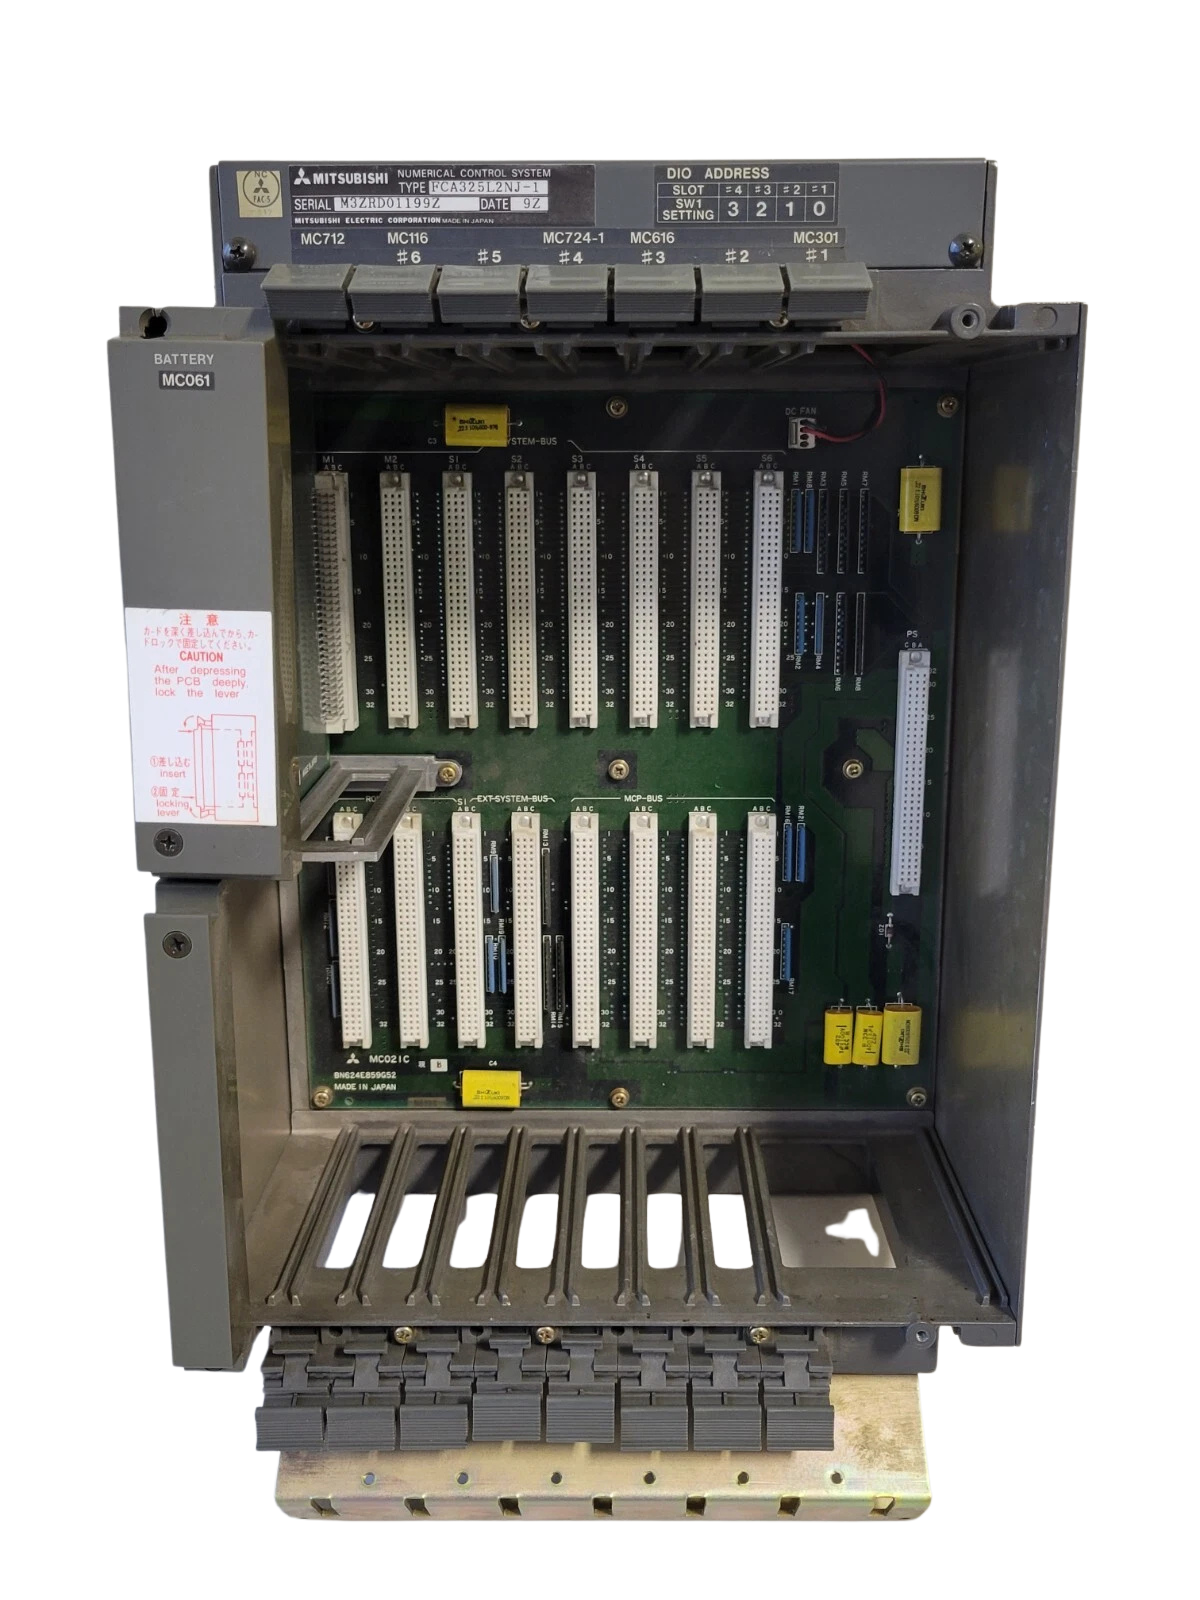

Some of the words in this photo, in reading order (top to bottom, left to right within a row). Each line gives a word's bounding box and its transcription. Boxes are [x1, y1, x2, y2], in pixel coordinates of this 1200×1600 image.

[313, 171, 389, 185] MITSUBISHI
[397, 168, 456, 178] NUMERICAL
[460, 168, 507, 178] CONTROL
[511, 168, 551, 178] SYSTEM
[666, 168, 692, 180] DIO
[704, 168, 770, 180] ADDRESS
[399, 182, 426, 194] TYPE
[431, 181, 540, 194] FCA325L2NJ-1
[672, 185, 704, 196] SLOT
[294, 199, 331, 211] SERIAL
[480, 198, 509, 211] DATE
[523, 198, 541, 210] 9Z
[675, 199, 702, 210] SW1
[727, 201, 739, 217] 3
[755, 201, 768, 217] 2
[785, 201, 795, 217] 1
[813, 201, 826, 217] 0
[294, 217, 341, 225] MITSUBISHI
[345, 217, 383, 225] ELECTRIC
[442, 217, 462, 225] MADE
[463, 217, 470, 225] IN
[470, 217, 495, 225] JAPAN
[662, 209, 715, 221] SETTING
[300, 232, 345, 246] MC712
[387, 232, 429, 245] MC116
[543, 232, 605, 245] MC724-1
[630, 231, 675, 245] MC616
[793, 231, 839, 244] MC301
[154, 353, 214, 365] BATTERY
[162, 373, 210, 387] MC061
[785, 407, 797, 416] DC
[800, 407, 817, 416] FAN
[906, 630, 919, 638] PS
[179, 650, 224, 663] CAUTION
[154, 664, 179, 674] After
[190, 666, 246, 680] depressing
[155, 677, 171, 686] the
[177, 677, 201, 686] PCB
[155, 688, 176, 697] lock
[187, 689, 204, 697] the
[214, 689, 240, 698] lever
[160, 769, 186, 778] insert
[156, 799, 189, 810] locking
[624, 795, 663, 803] MCP-BUS
[157, 809, 180, 817] lever
[334, 1083, 357, 1091] MADE
[358, 1083, 369, 1091] IN
[370, 1083, 397, 1091] JAPAN
